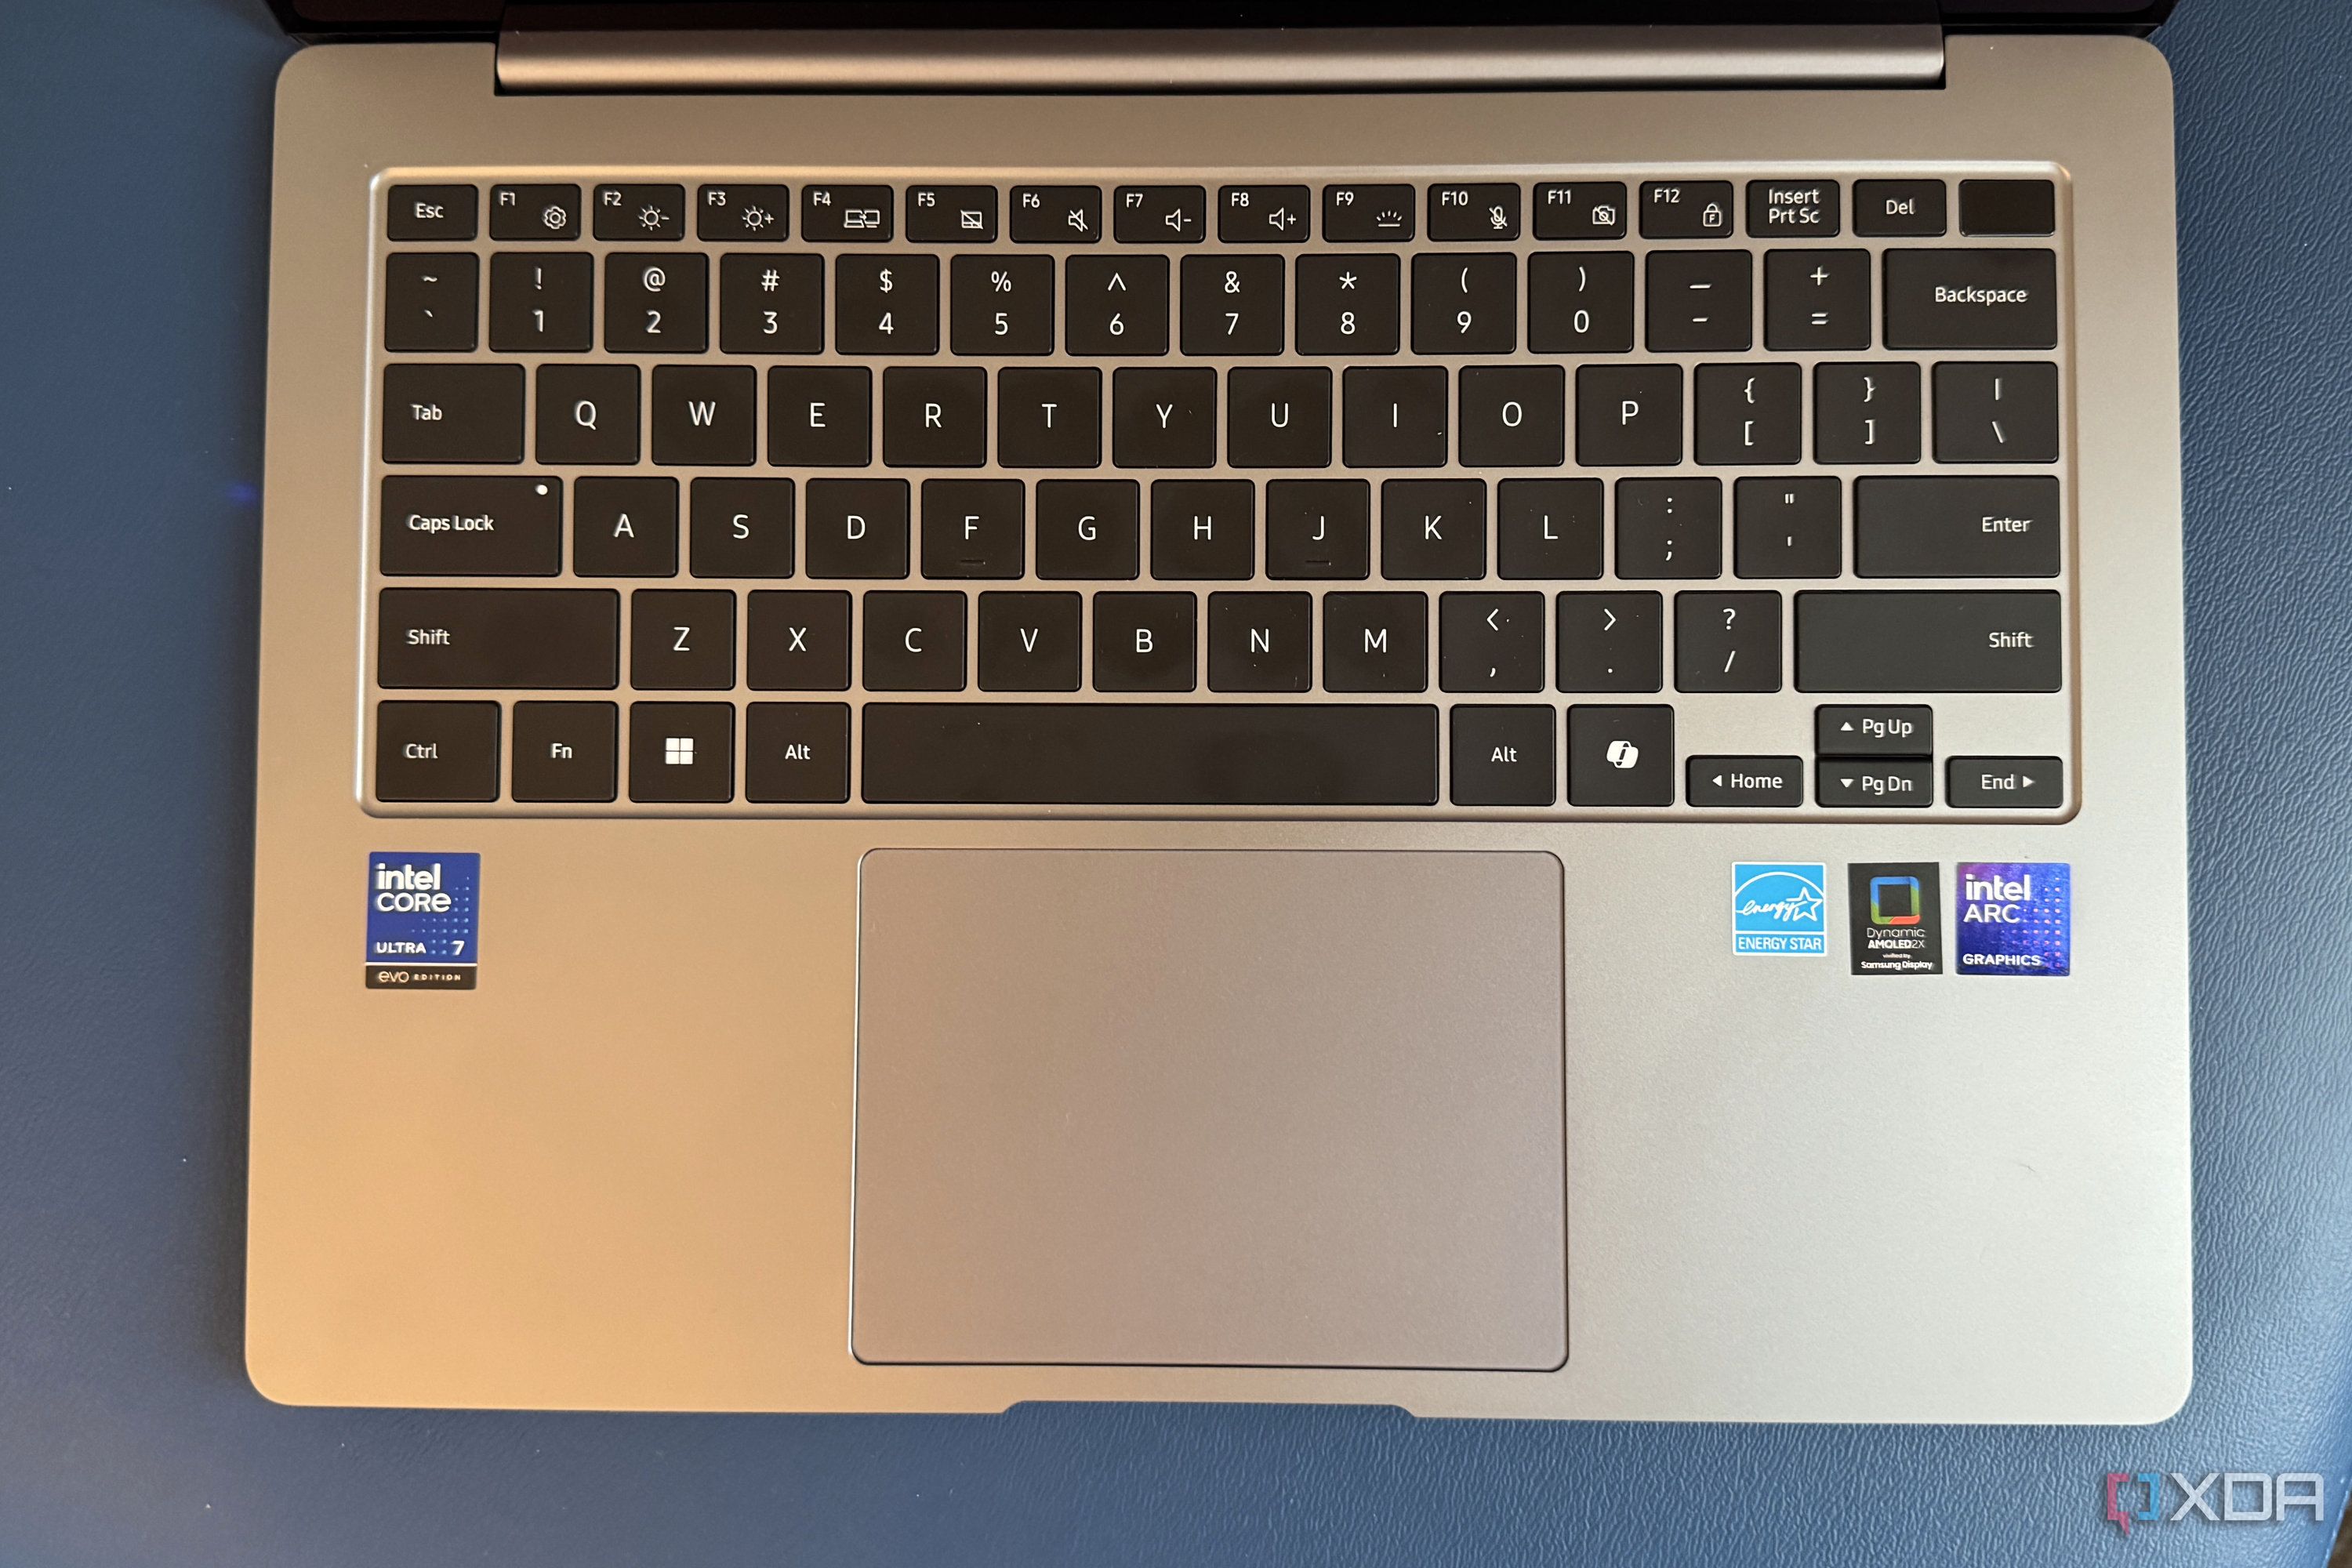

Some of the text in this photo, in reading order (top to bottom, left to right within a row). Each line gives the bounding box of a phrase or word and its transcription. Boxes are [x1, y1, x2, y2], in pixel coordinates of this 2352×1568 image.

[500, 191, 516, 206] F1
[604, 191, 622, 206] F2
[708, 191, 726, 206] F3
[813, 191, 832, 206] F4
[917, 192, 935, 207] F5
[1022, 193, 1040, 209] F6
[1126, 193, 1143, 208] F7
[1231, 192, 1250, 207] F8
[1336, 191, 1354, 206] F9
[1442, 191, 1468, 206] F10
[1548, 190, 1571, 205] F11
[1653, 188, 1680, 203] F12
[1769, 189, 1820, 205] Insert
[1886, 198, 1915, 215] Del
[416, 202, 444, 219] Esc
[1769, 207, 1819, 224] Prt Sc
[536, 267, 542, 290] !
[644, 267, 666, 292] @
[760, 269, 780, 292] #
[880, 268, 893, 293] $
[991, 270, 1011, 292] %
[1224, 270, 1240, 293] &
[1461, 267, 1468, 293] (
[1578, 267, 1586, 292] )
[1809, 267, 1828, 286] +
[1935, 285, 2027, 307] Backspace
[534, 310, 543, 332] 1
[647, 310, 661, 333] 2
[763, 311, 778, 334] 3
[878, 312, 895, 335] 4
[995, 312, 1008, 336] 5
[1109, 313, 1124, 336] 6
[1225, 313, 1239, 336] 7
[1340, 311, 1356, 335] 8
[1457, 310, 1472, 334] 9
[1573, 310, 1590, 333] 0
[1811, 313, 1827, 325] =
[1744, 377, 1755, 404] {
[1864, 376, 1875, 403] }
[412, 404, 442, 421] Tab
[575, 400, 597, 430] Q
[688, 401, 716, 426] W
[810, 402, 826, 427] E
[925, 403, 942, 428] R
[1041, 403, 1058, 428] T
[1156, 404, 1173, 429] Y
[1271, 402, 1289, 428] U
[1393, 403, 1398, 428] I
[1502, 401, 1523, 427] O
[1622, 401, 1639, 426] P
[1744, 420, 1754, 446] [
[1864, 419, 1874, 445] ]
[1991, 421, 2004, 444] \
[1667, 497, 1673, 514] :
[408, 514, 495, 534] Caps Lock
[614, 514, 634, 538] A
[733, 514, 750, 539] S
[847, 515, 866, 539] D
[964, 515, 980, 540] F
[1078, 516, 1096, 541] G
[1193, 515, 1211, 540] H
[1312, 515, 1325, 541] J
[1425, 515, 1443, 540] K
[1544, 515, 1559, 539] L
[1982, 517, 2031, 532] Enter
[1665, 540, 1672, 561] ;
[1486, 608, 1499, 631] <
[1604, 608, 1617, 631] >
[1722, 608, 1736, 630] ?
[408, 629, 451, 645] Shift
[673, 626, 690, 652] Z
[789, 627, 807, 652] X
[905, 627, 922, 652] C
[1020, 628, 1039, 652] V
[1136, 628, 1153, 653] B
[1250, 628, 1269, 653] N
[1364, 628, 1387, 653] M
[1988, 631, 2033, 648] Shift
[1724, 650, 1736, 673] /
[1862, 718, 1912, 739] Pg Up
[405, 742, 438, 759] Ctrl
[551, 742, 572, 759] Fn
[785, 743, 811, 760] Alt
[1490, 746, 1517, 762] Alt
[1731, 773, 1783, 789] Home
[1862, 775, 1912, 796] Pg Dn
[1981, 774, 2015, 790] End
[376, 863, 441, 890] intel
[1965, 873, 2031, 901] intel
[1963, 903, 2020, 923] ARC
[1738, 937, 1822, 950] ENERGY STAR
[1867, 927, 1926, 939] Dynamic
[376, 940, 465, 955] ULTRA 7
[1860, 960, 1933, 970] Samsung Display
[1962, 953, 2042, 966] GRAPHICS
[378, 971, 409, 982] evo
